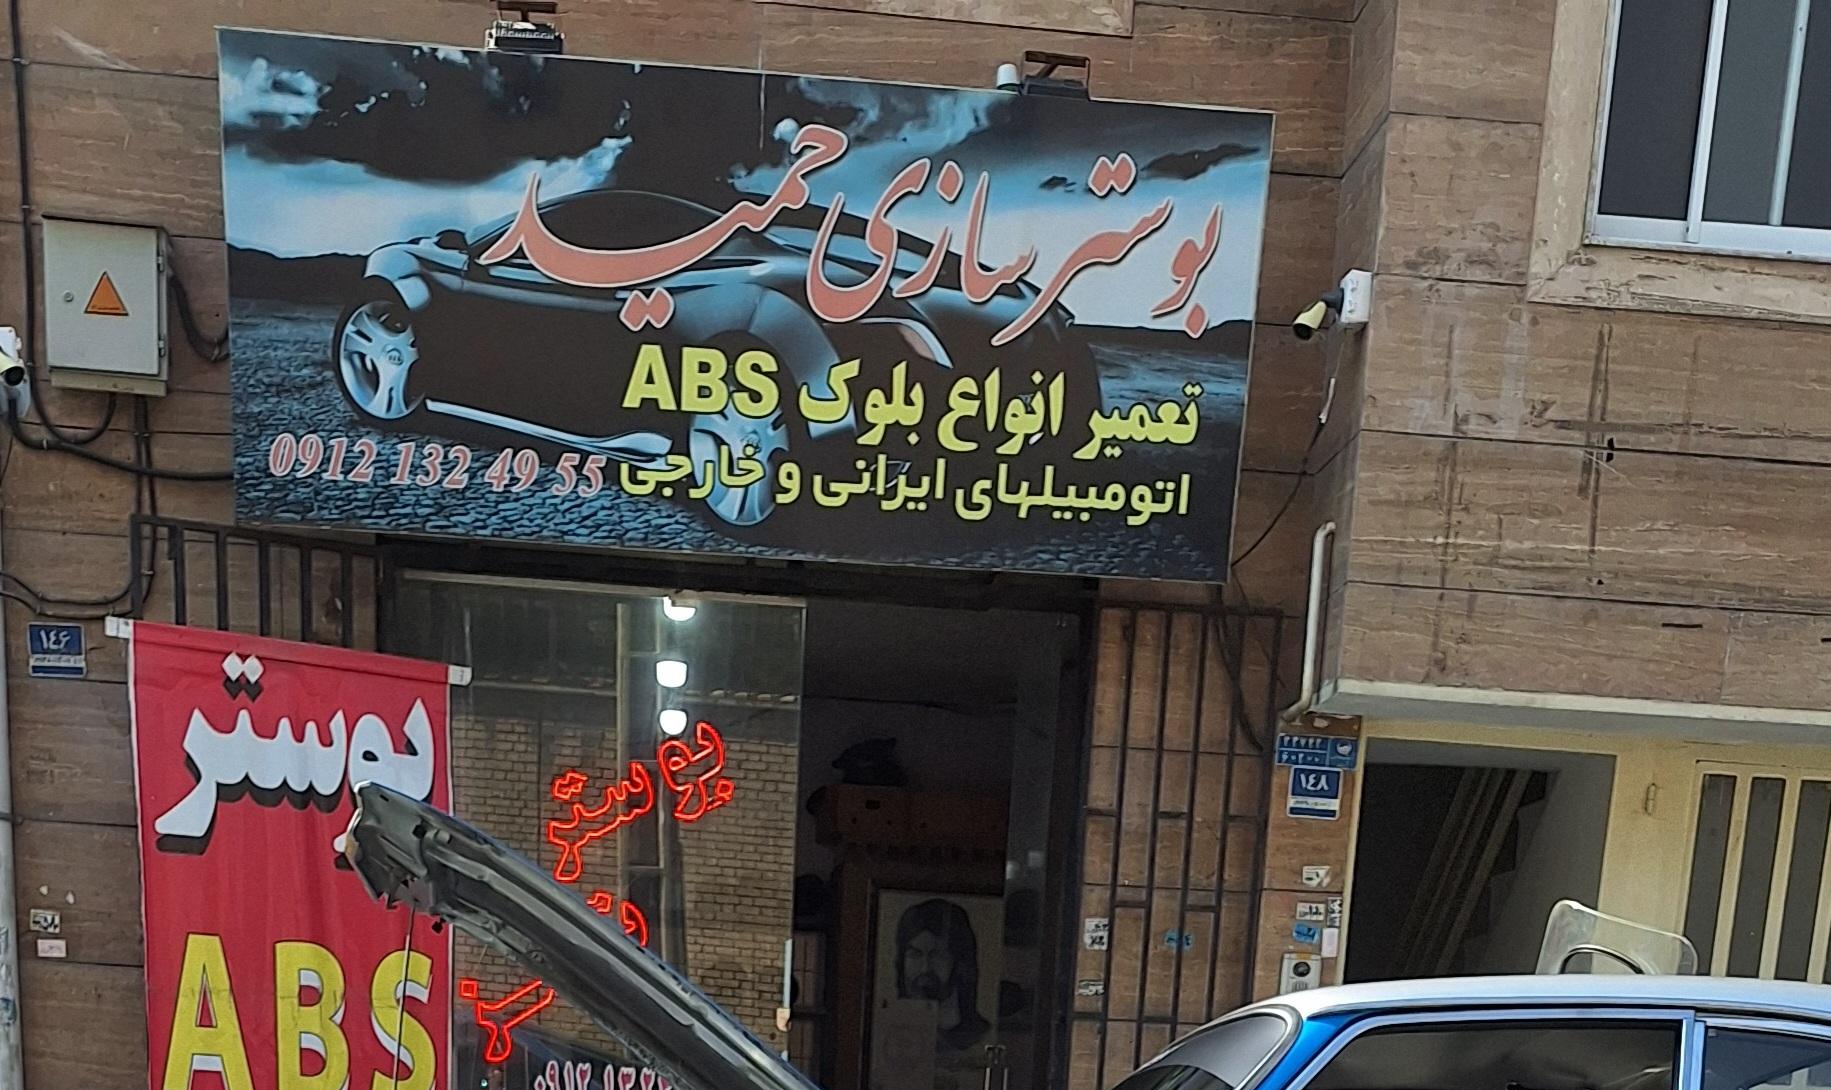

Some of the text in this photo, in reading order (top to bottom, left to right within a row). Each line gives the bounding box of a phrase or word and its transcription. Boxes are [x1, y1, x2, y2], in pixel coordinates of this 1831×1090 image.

[475, 123, 1222, 346] بوستر سازی حمید
[621, 344, 1204, 460] تعمیر انواع بلوک ABS
[268, 432, 607, 498] 0912 132 49 55
[618, 443, 1191, 526] اتومبیلهای ایرانی و خارجی
